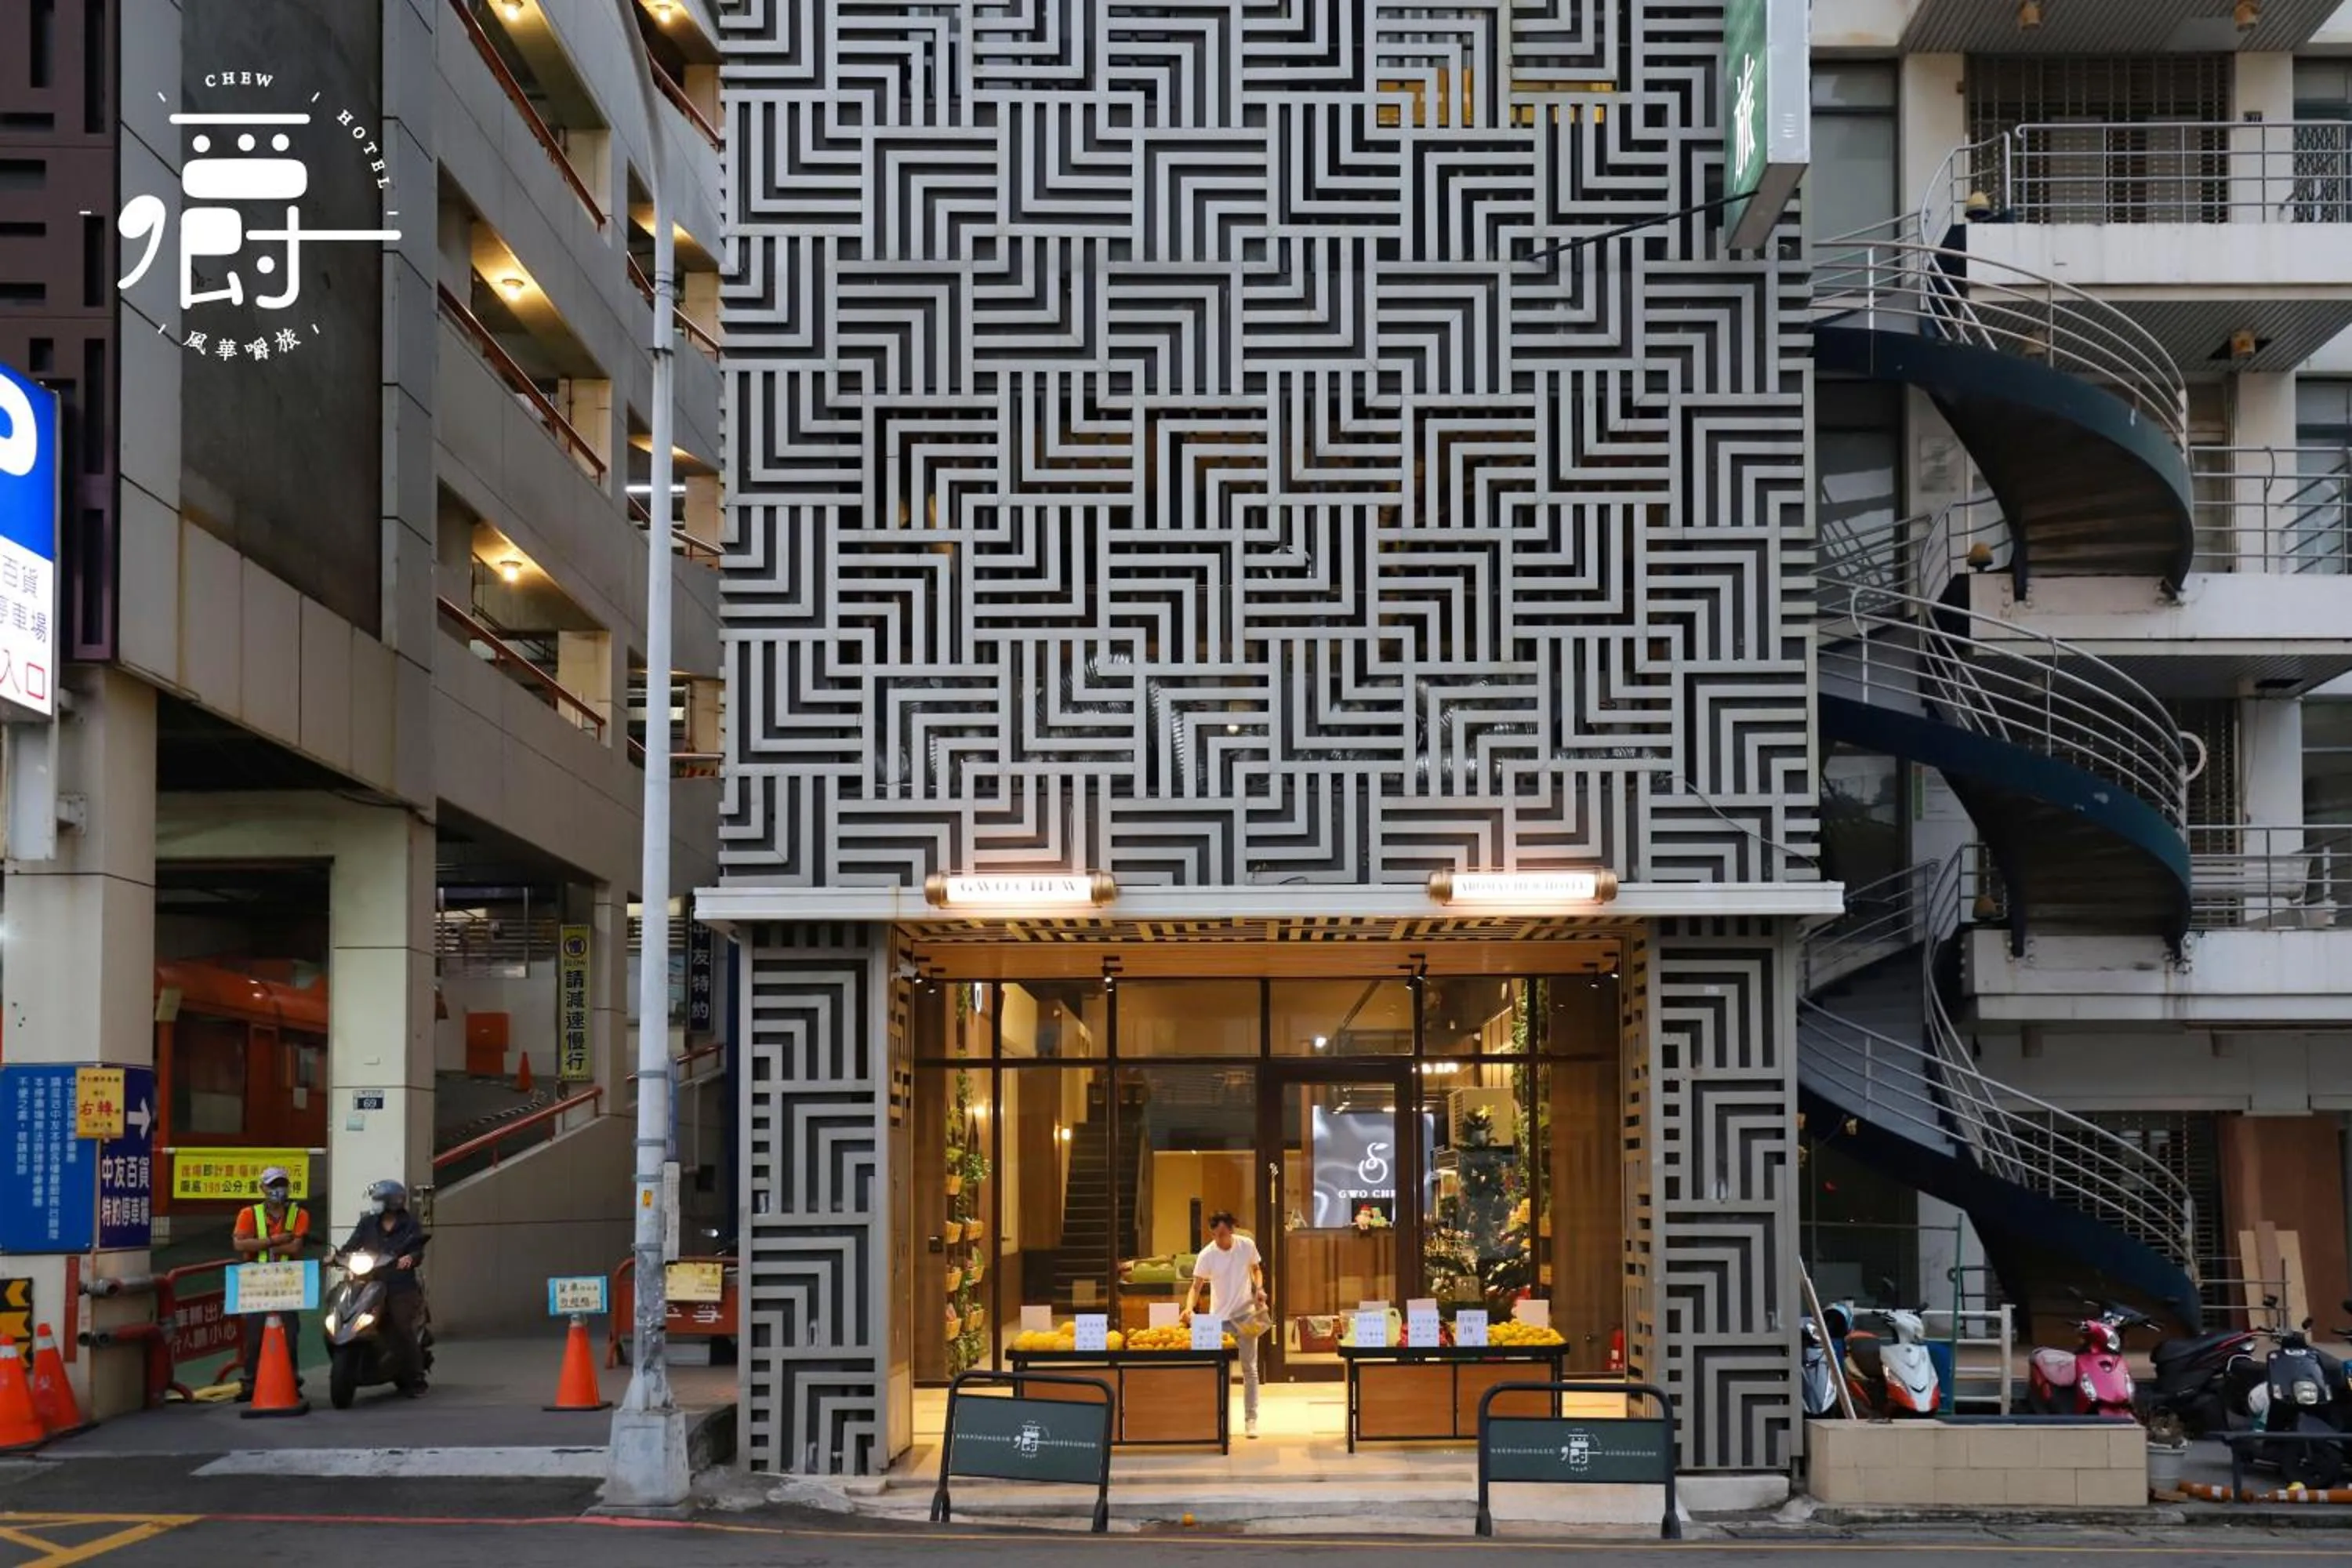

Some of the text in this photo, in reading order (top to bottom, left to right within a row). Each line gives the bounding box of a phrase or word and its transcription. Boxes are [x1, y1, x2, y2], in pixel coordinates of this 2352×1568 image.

[0, 648, 45, 700] 入口
[565, 969, 586, 1071] 請減速慢行
[80, 1100, 114, 1116] 右轉
[101, 1156, 150, 1189] 中友百貨
[1338, 1189, 1368, 1199] GWO
[101, 1196, 149, 1227] 特約停車場
